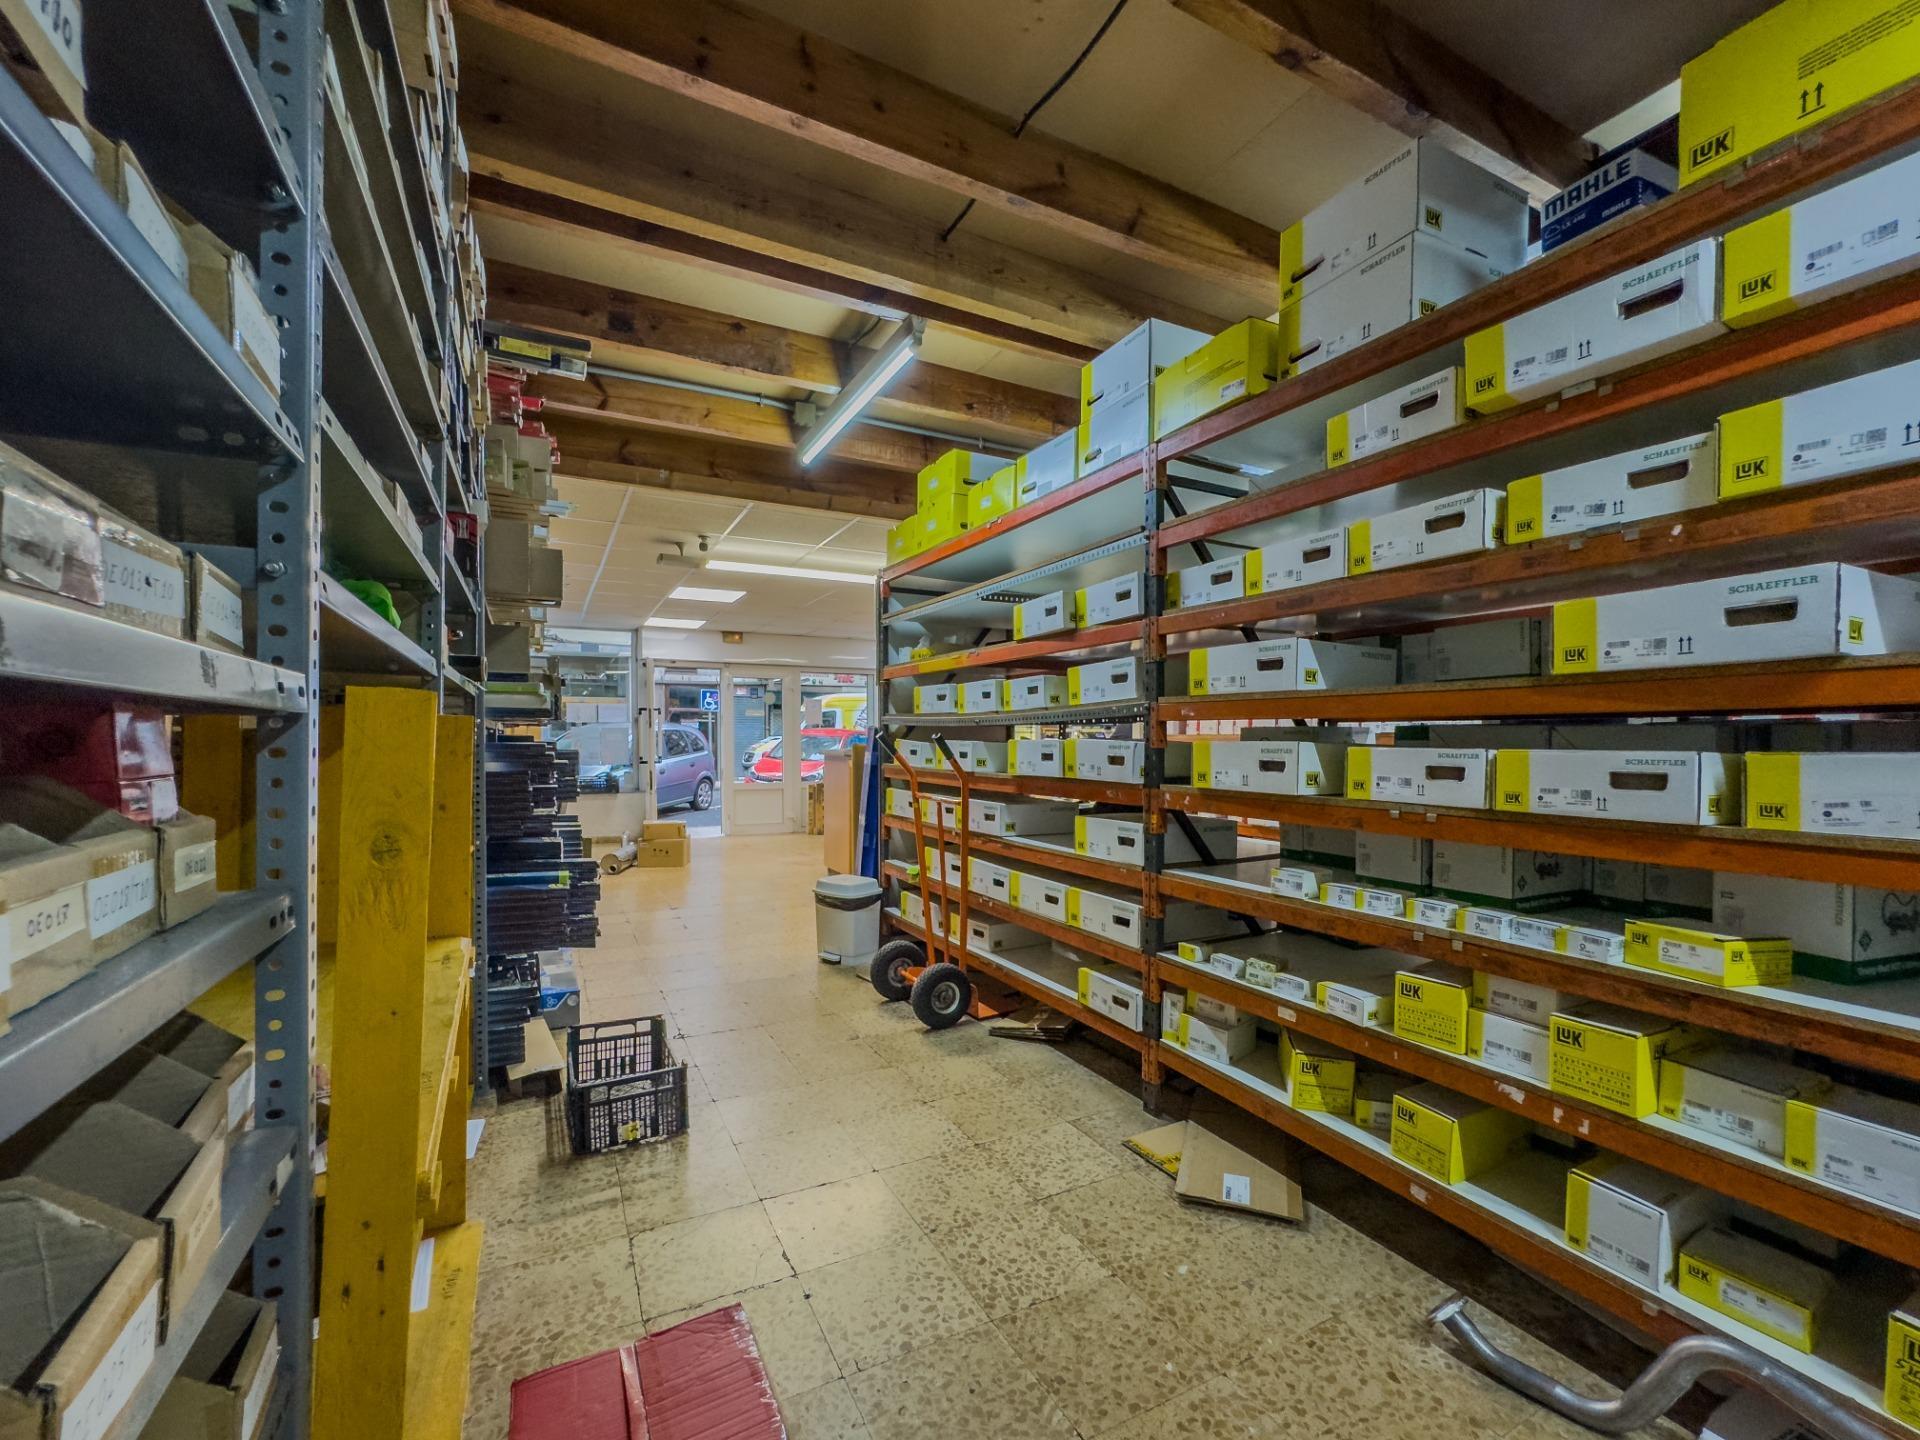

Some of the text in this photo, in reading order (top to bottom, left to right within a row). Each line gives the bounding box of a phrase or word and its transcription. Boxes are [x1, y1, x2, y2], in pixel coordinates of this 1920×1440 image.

[1364, 148, 1412, 185] SCHAEFFLER
[1545, 157, 1633, 221] MAHLE
[1622, 252, 1700, 291] SCHAEFFLER
[1642, 440, 1709, 462] SCHAEFFLER
[1727, 574, 1819, 595] SCHAEFFLER
[1437, 752, 1480, 760] SCHAEFFLER
[1624, 757, 1688, 767] SCHAEFFLER
